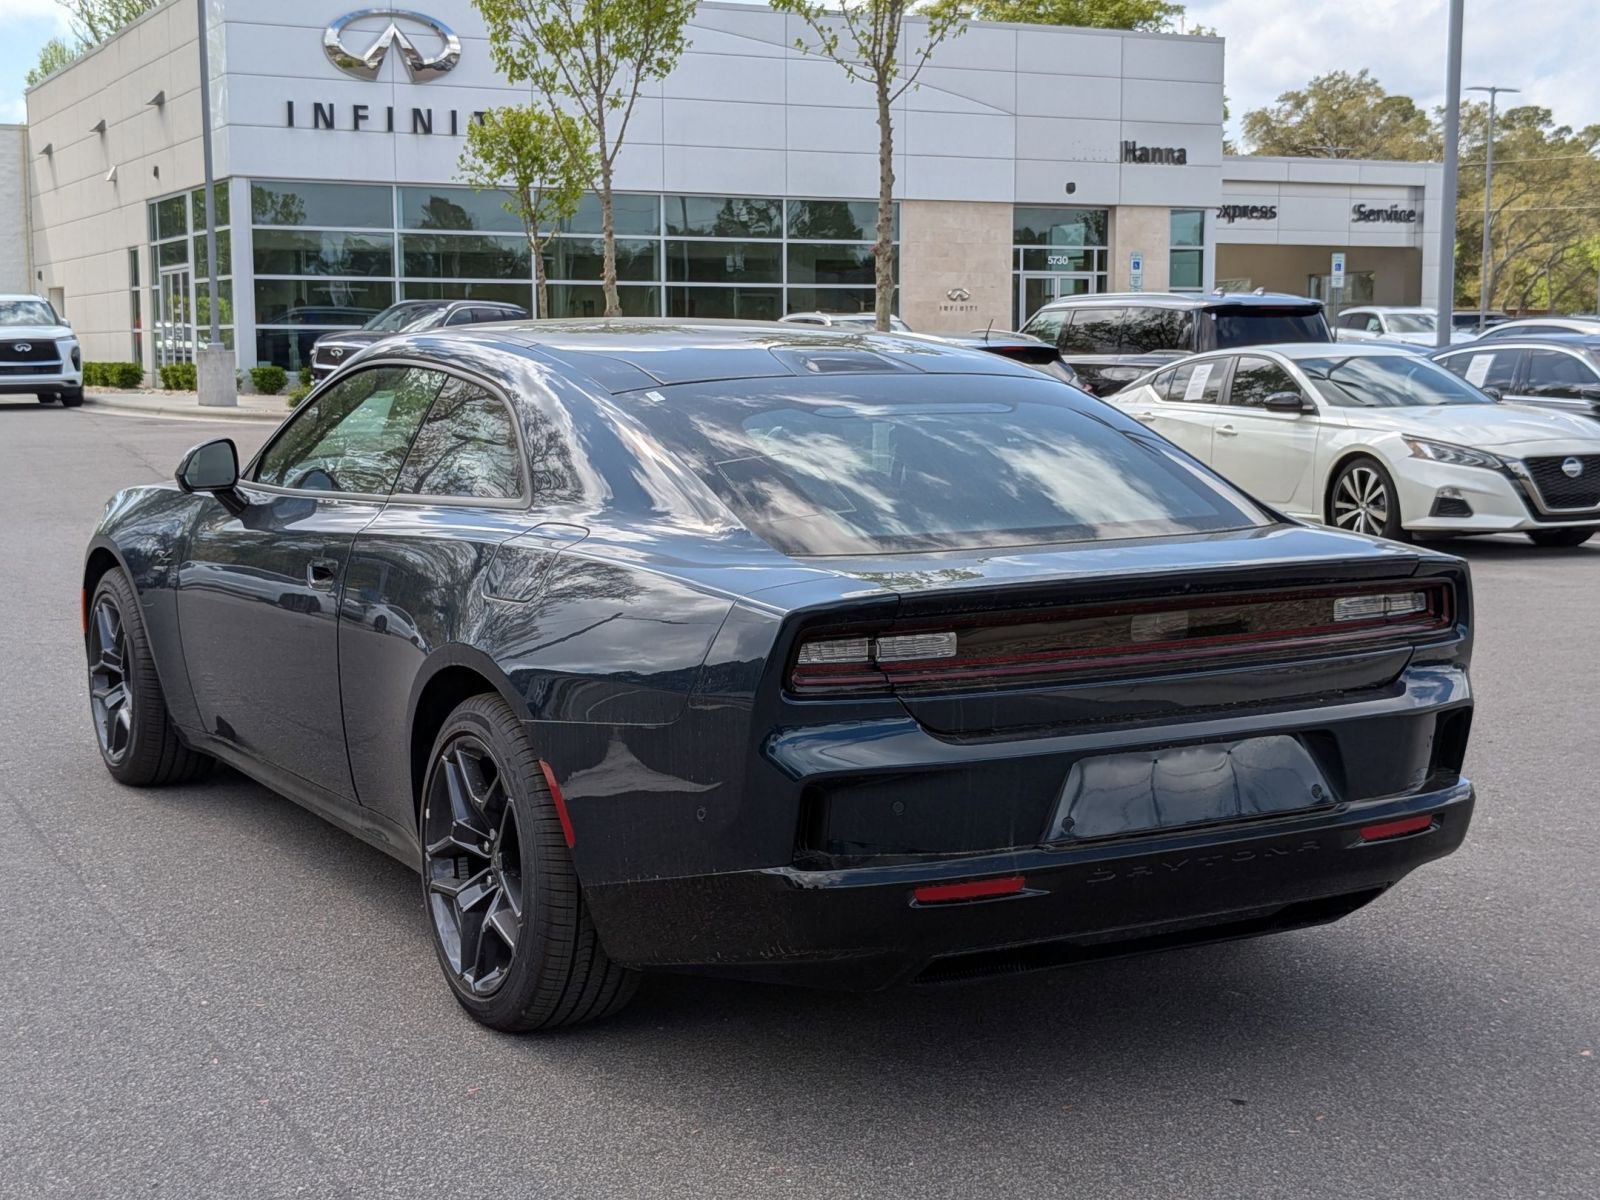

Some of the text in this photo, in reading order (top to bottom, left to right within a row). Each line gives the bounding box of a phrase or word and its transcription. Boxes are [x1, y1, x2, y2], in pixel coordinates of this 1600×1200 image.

[286, 100, 491, 137] INFINIT
[1121, 140, 1187, 165] Hanna
[1217, 204, 1277, 223] xpress
[1353, 203, 1416, 223] Service
[1047, 255, 1069, 265] 5730
